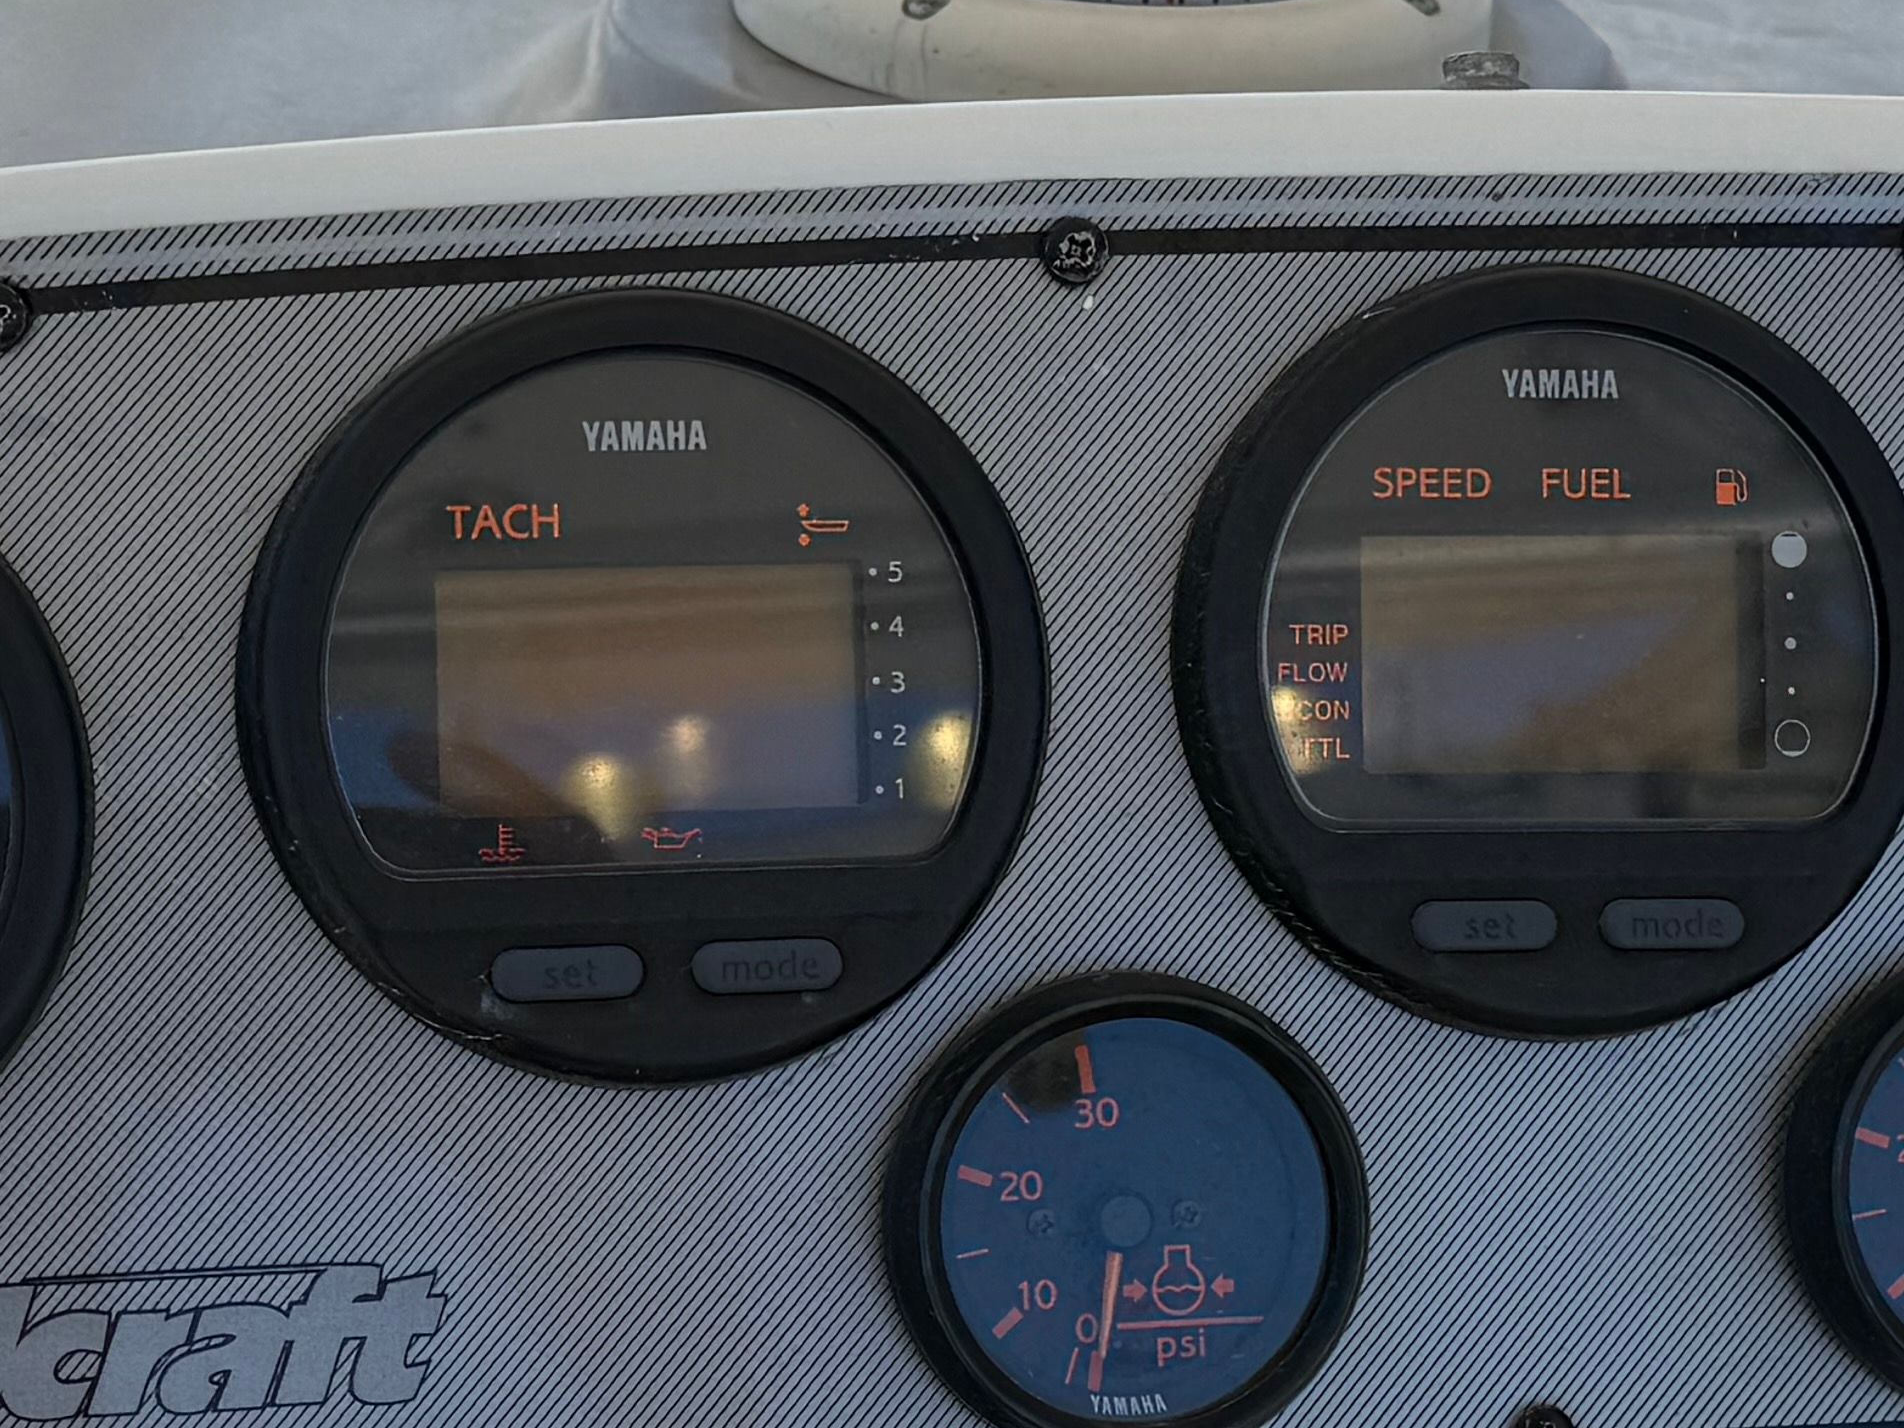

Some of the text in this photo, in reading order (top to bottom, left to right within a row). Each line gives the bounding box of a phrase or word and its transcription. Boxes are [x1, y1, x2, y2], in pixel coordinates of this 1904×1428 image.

[1502, 369, 1619, 400] YAMAHA
[582, 419, 707, 452] YAMAHA
[1372, 468, 1631, 499] SPEED FUEL
[446, 503, 560, 540] TACH
[888, 562, 904, 583] 5
[889, 616, 905, 637] 4
[1289, 624, 1349, 645] TRIP
[891, 672, 906, 693] 3
[1278, 662, 1348, 683] FLOW
[1286, 700, 1350, 721] CON
[892, 725, 908, 746] 2
[895, 779, 905, 799] 1
[1465, 910, 1517, 940] set
[1631, 909, 1724, 939] mode
[544, 957, 598, 989] set
[721, 950, 819, 981] mode
[1074, 1098, 1120, 1129] 30
[999, 1170, 1043, 1202] 20
[1017, 1279, 1057, 1310] 10
[1075, 1313, 1097, 1344] 0
[1156, 1328, 1206, 1367] psi
[1090, 1392, 1168, 1416] YAMAHA
